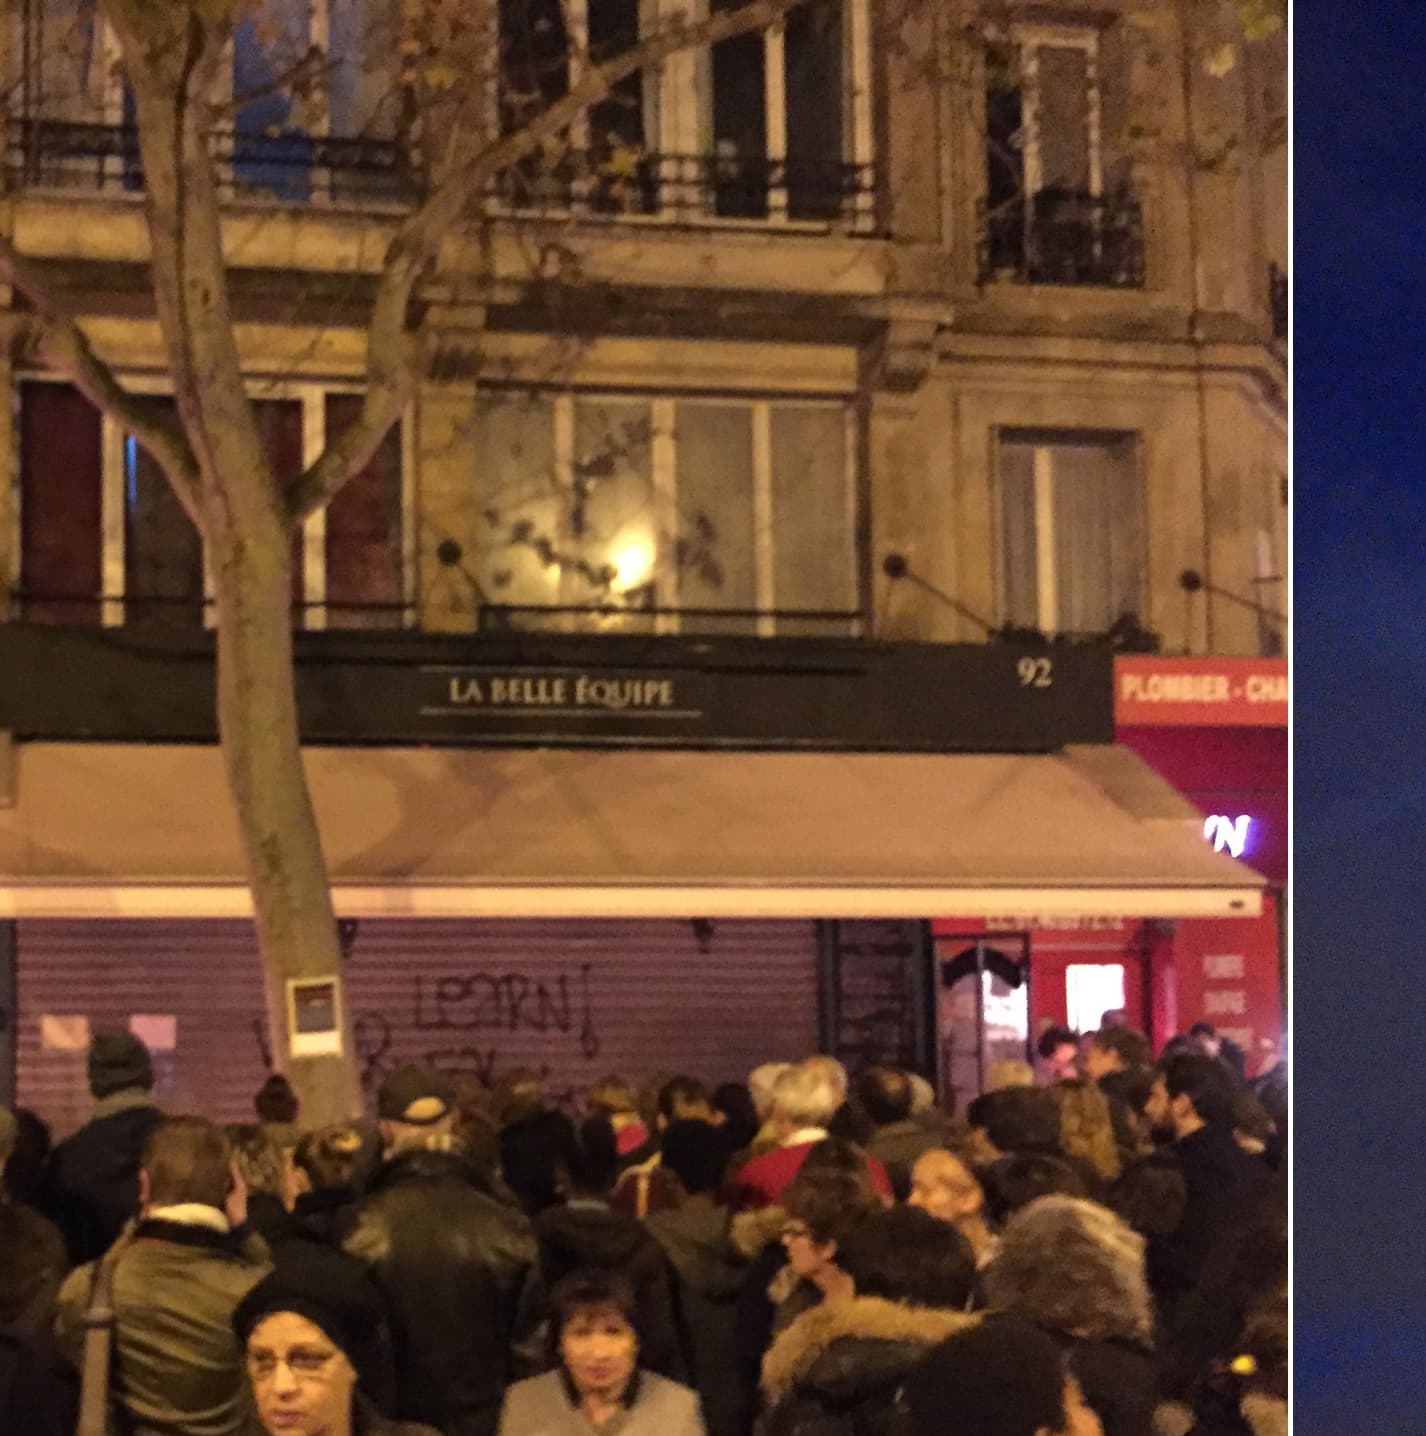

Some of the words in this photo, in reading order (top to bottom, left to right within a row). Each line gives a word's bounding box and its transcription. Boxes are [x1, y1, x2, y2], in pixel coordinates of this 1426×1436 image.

[1017, 656, 1053, 688] 92
[1120, 673, 1230, 703] PLOMBIER
[451, 677, 483, 702] LA
[491, 677, 567, 705] BELLE
[574, 673, 674, 708] ÉQUIPE
